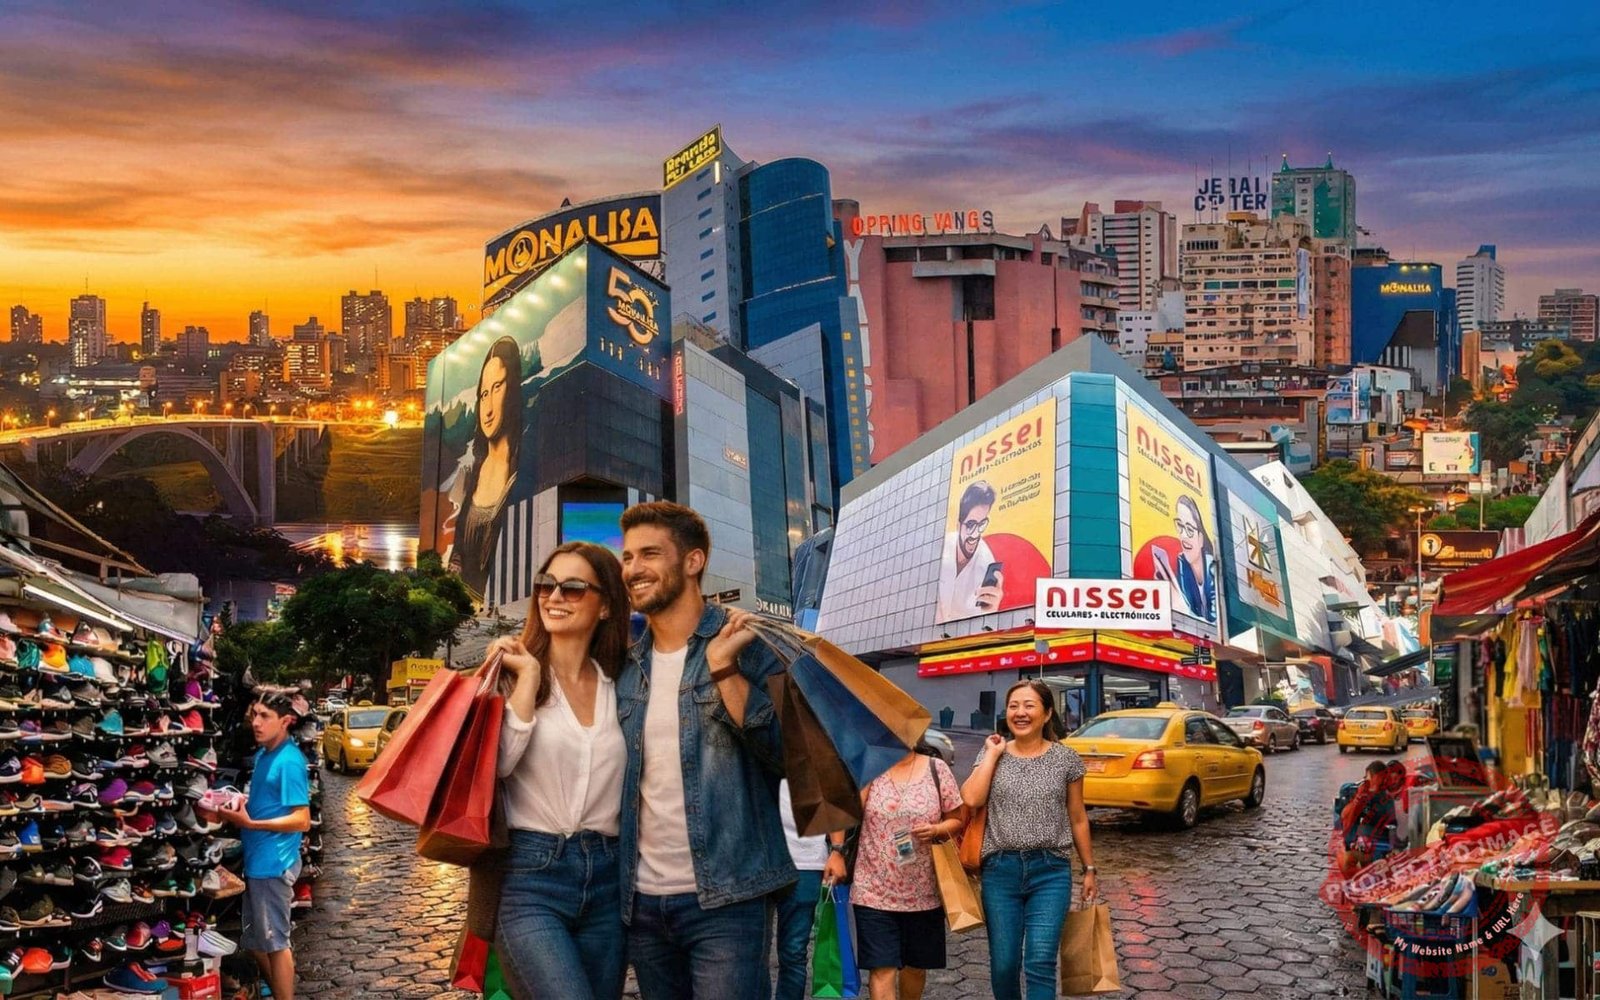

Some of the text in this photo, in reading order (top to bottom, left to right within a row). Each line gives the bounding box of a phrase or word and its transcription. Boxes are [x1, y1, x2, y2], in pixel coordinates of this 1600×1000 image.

[934, 210, 994, 231] VANGS
[485, 207, 659, 284] MONALISA
[1046, 611, 1093, 619] CELULARES
